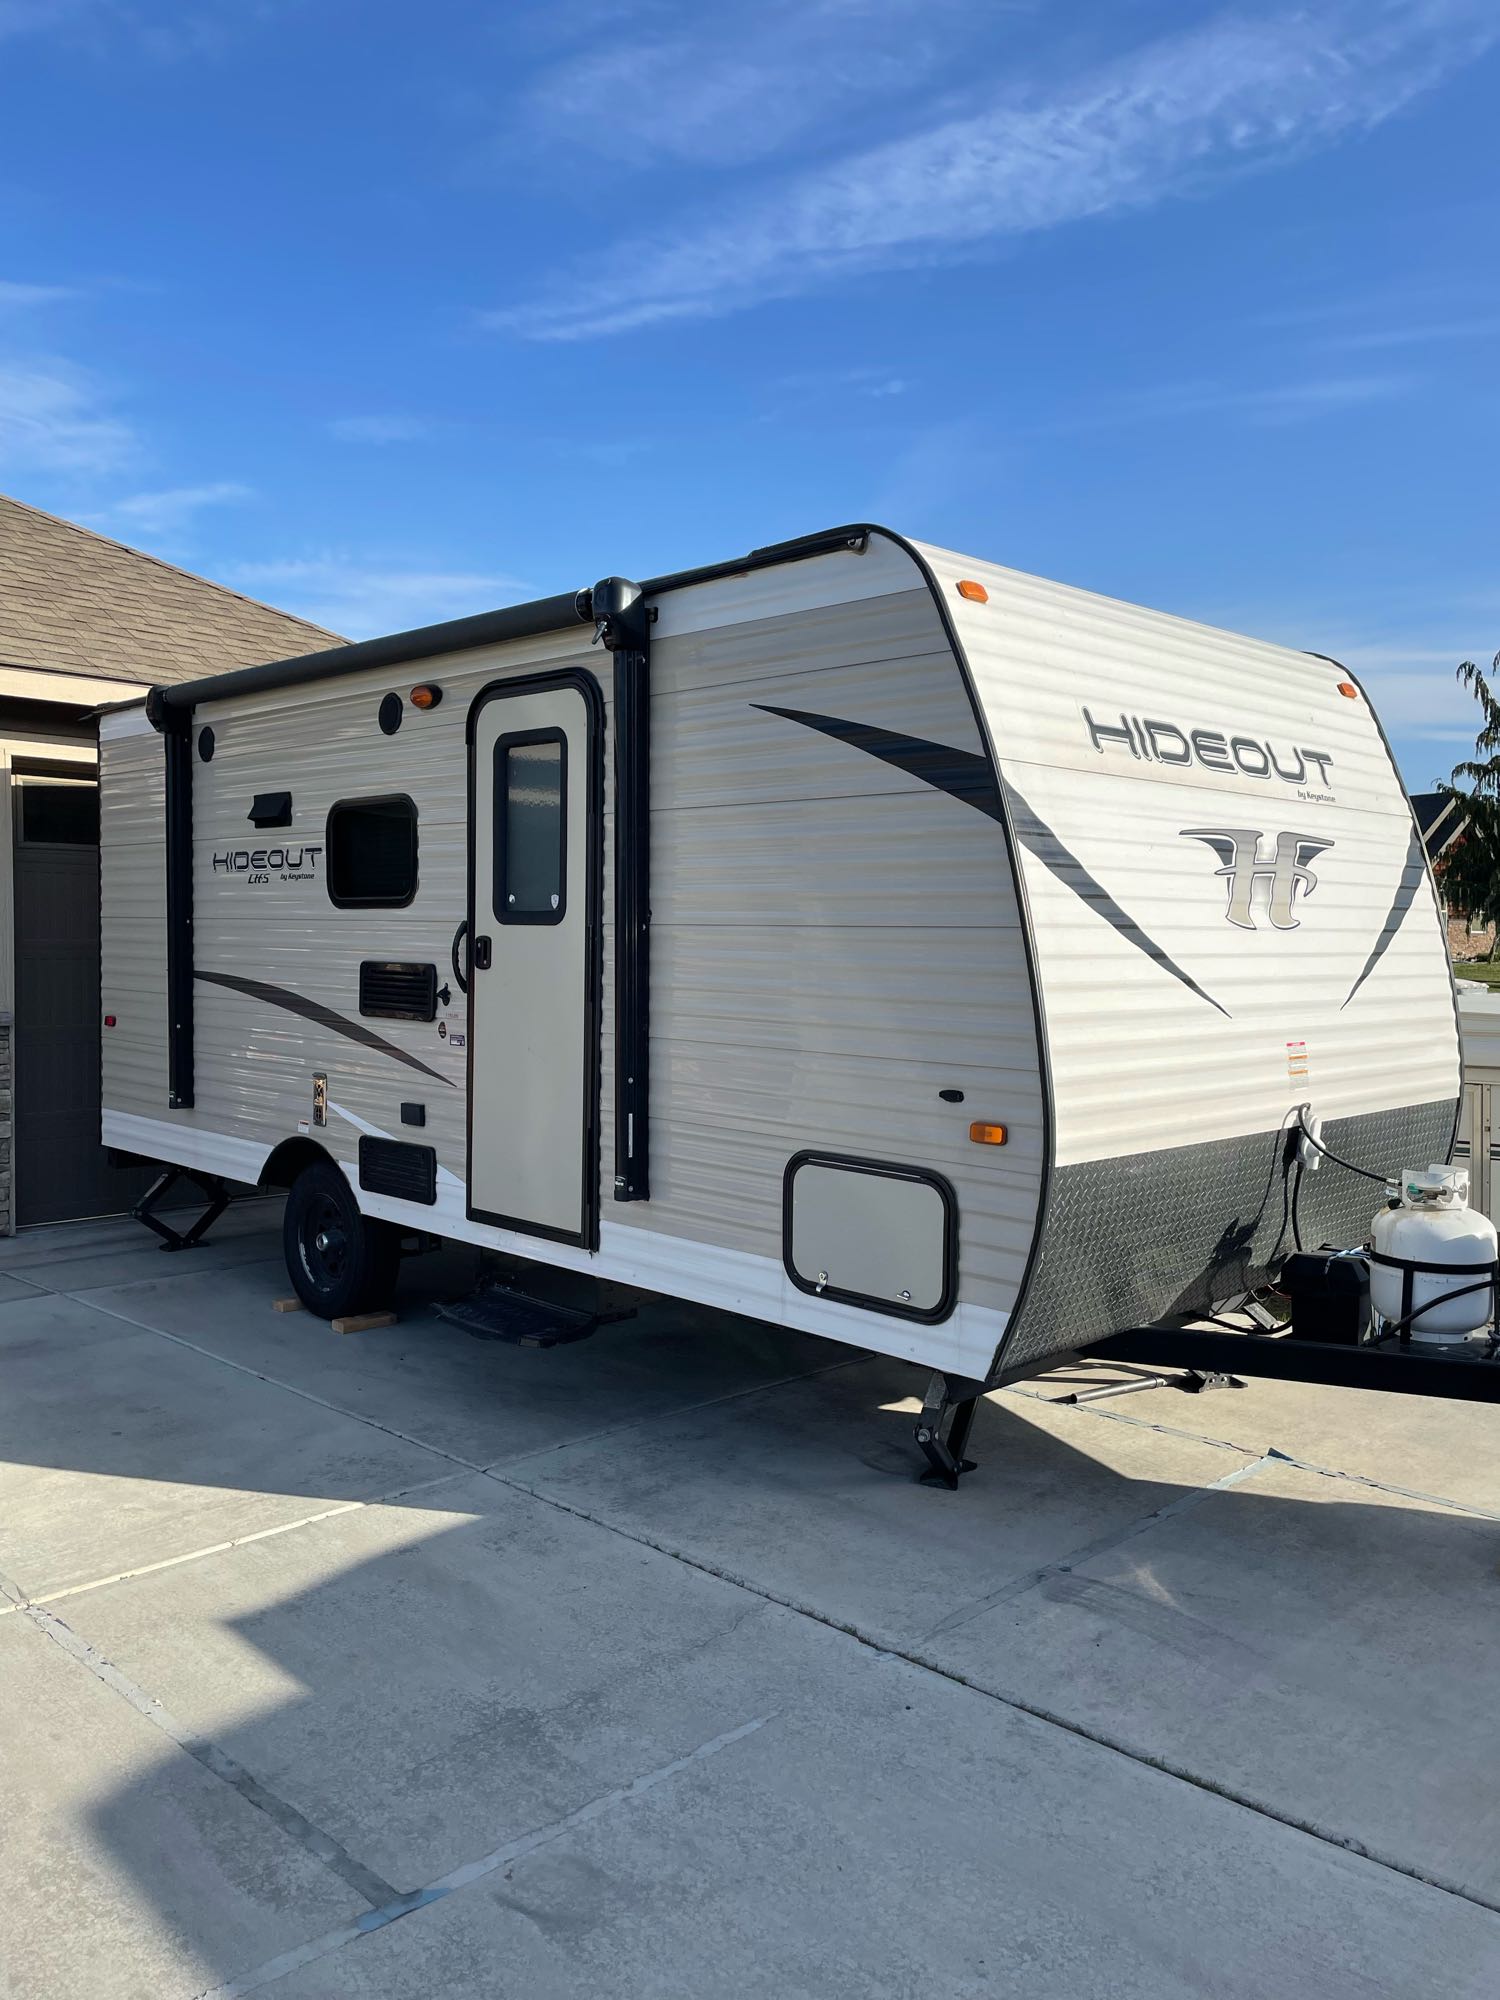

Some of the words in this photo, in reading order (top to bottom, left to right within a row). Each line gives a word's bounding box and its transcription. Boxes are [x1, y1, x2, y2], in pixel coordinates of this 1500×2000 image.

[1081, 706, 1334, 789] HIDEOUT
[1297, 789, 1306, 801] by
[212, 847, 322, 873] HIDEOUT
[280, 873, 288, 882] by
[288, 873, 315, 881] Keystone
